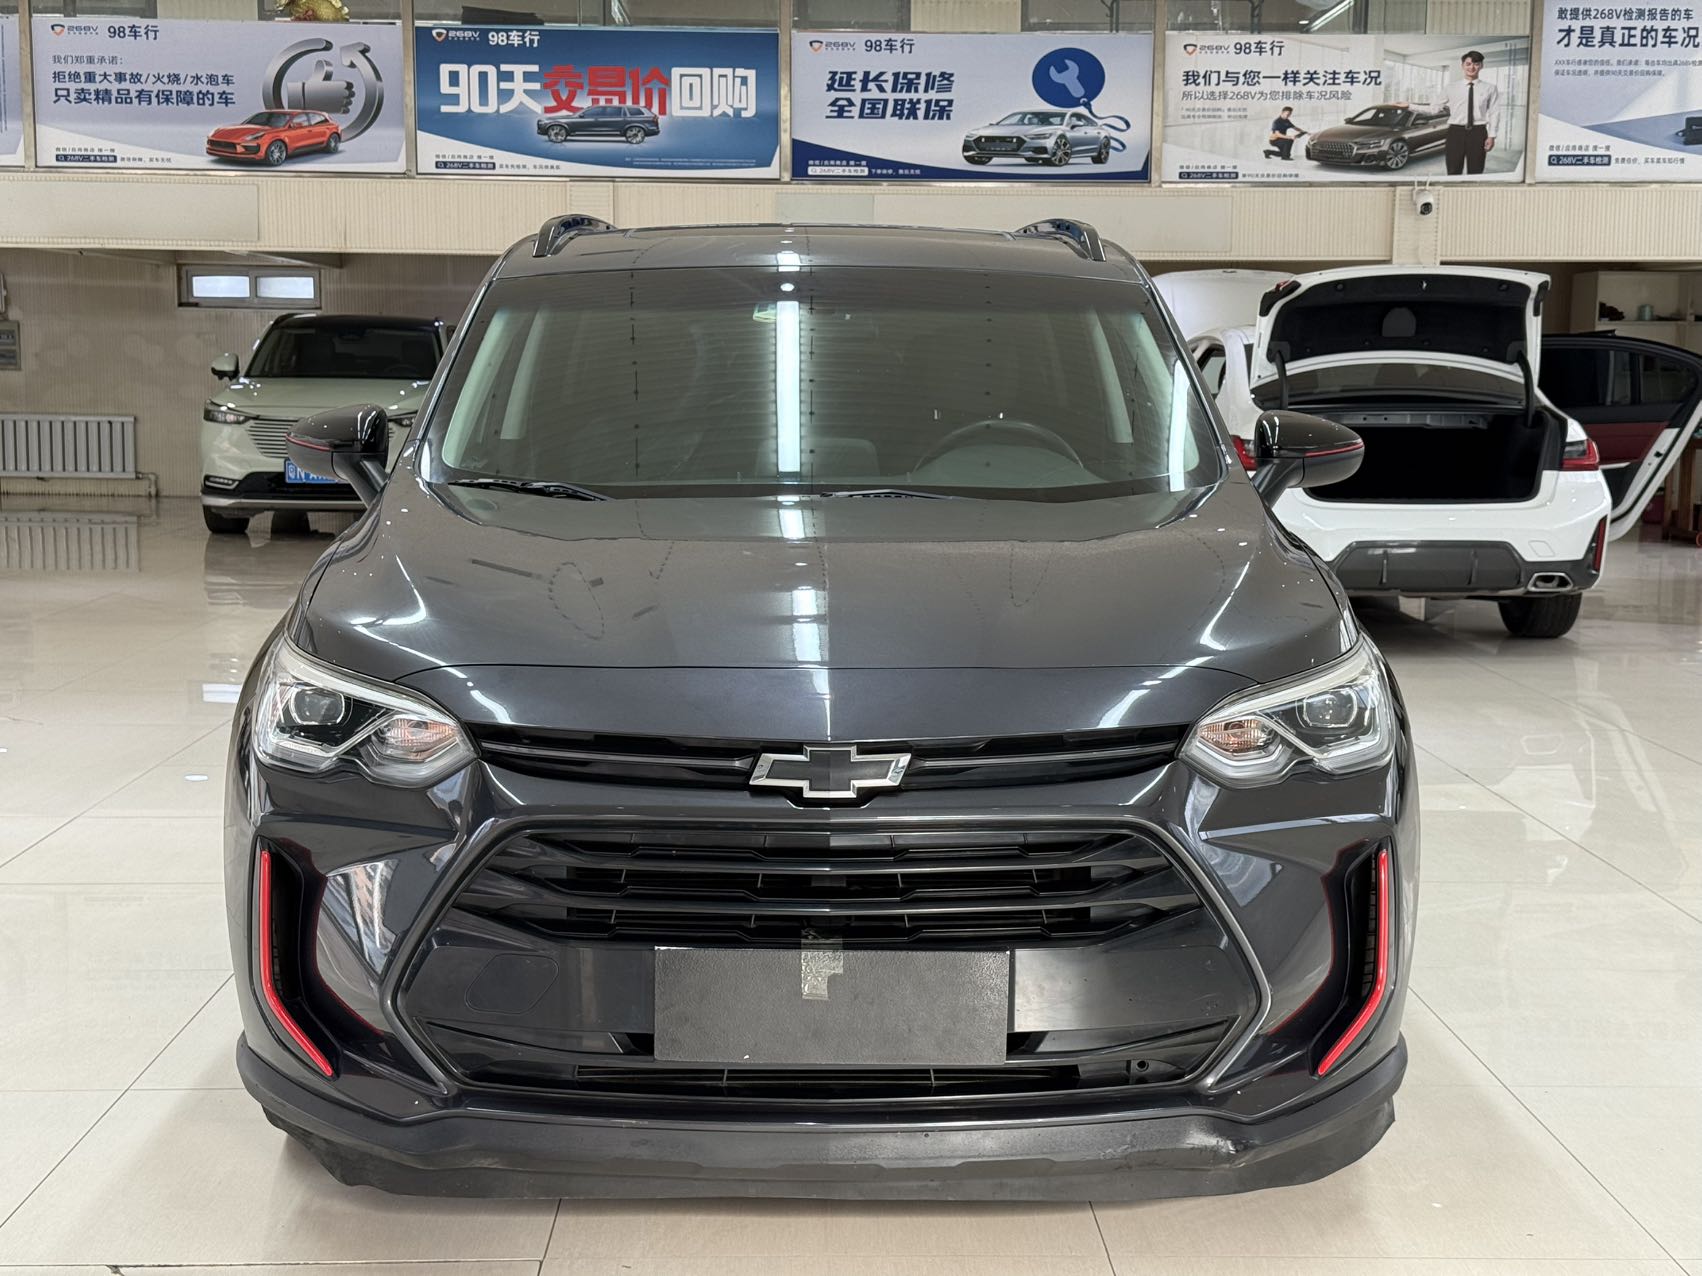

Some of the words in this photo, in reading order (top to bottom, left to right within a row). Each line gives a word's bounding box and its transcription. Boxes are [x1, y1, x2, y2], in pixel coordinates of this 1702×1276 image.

[1557, 7, 1694, 21] 敢提供268V检测报告的车
[107, 24, 160, 40] 98车行
[488, 30, 541, 47] 98车行
[1556, 25, 1700, 48] 才是真正的车况
[864, 38, 915, 54] 98车行
[1234, 40, 1285, 56] 98车行
[52, 70, 235, 86] 拒绝重大事故/火烧/水泡车
[825, 71, 955, 94] 延长保修
[1182, 70, 1382, 87] 我们与您一样关注车况
[53, 87, 236, 107] 只卖精品有保障的车
[439, 63, 756, 117] 90天交易价回购
[1181, 90, 1353, 101] 所以选择268V为您排除车况风险
[825, 97, 954, 121] 全国联保
